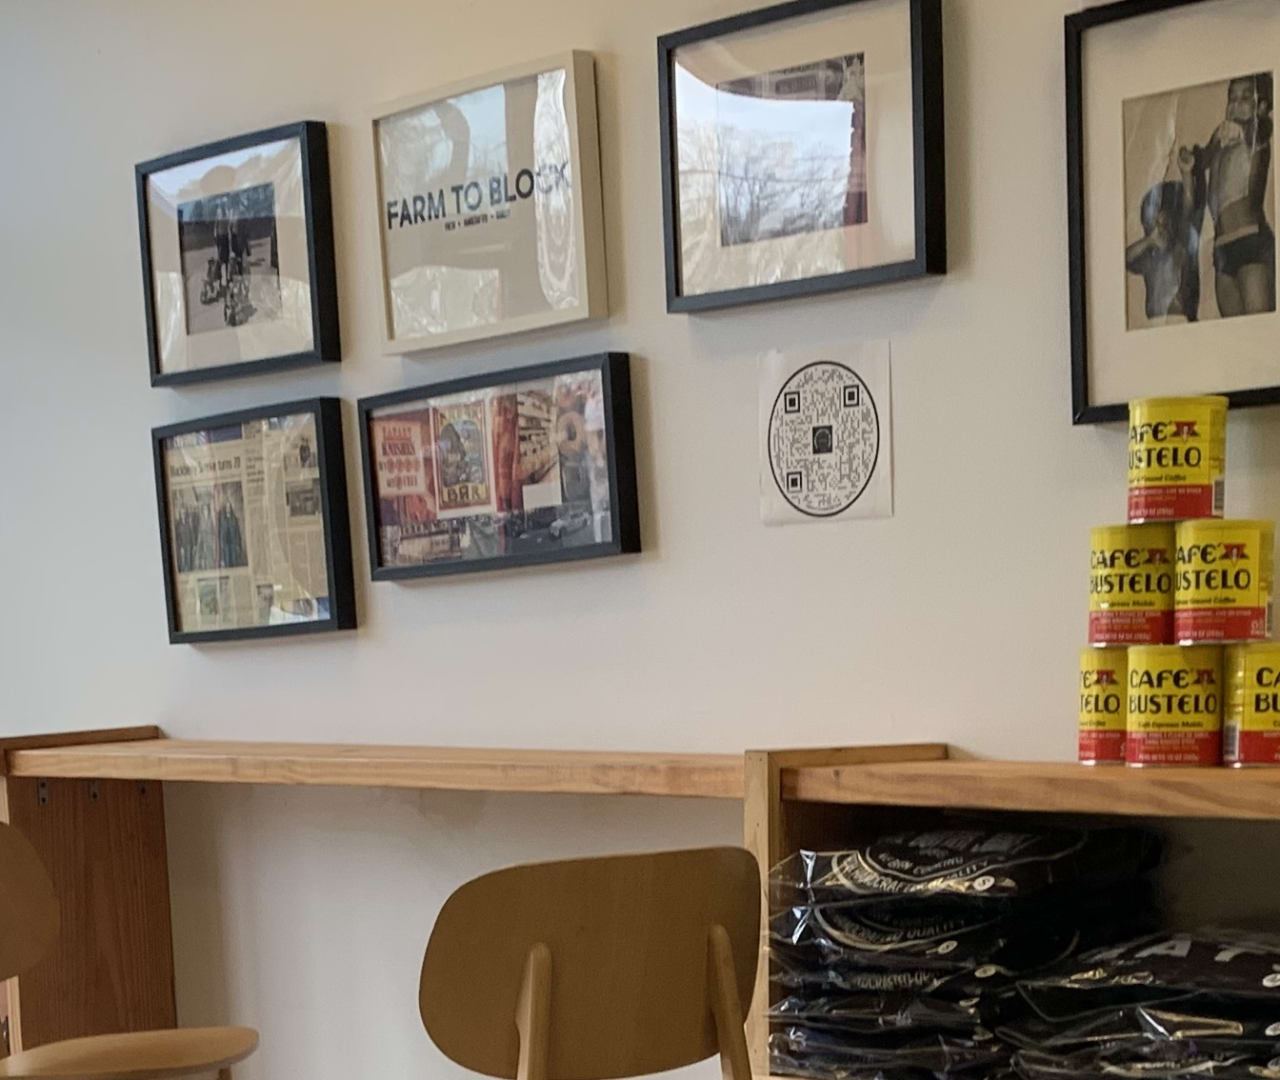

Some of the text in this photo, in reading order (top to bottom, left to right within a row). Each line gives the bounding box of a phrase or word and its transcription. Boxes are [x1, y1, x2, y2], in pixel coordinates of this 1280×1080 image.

[387, 188, 446, 230] FARM
[451, 181, 482, 214] TO
[1090, 573, 1172, 594] BUSTELO
[1129, 693, 1218, 714] BUSTELO
